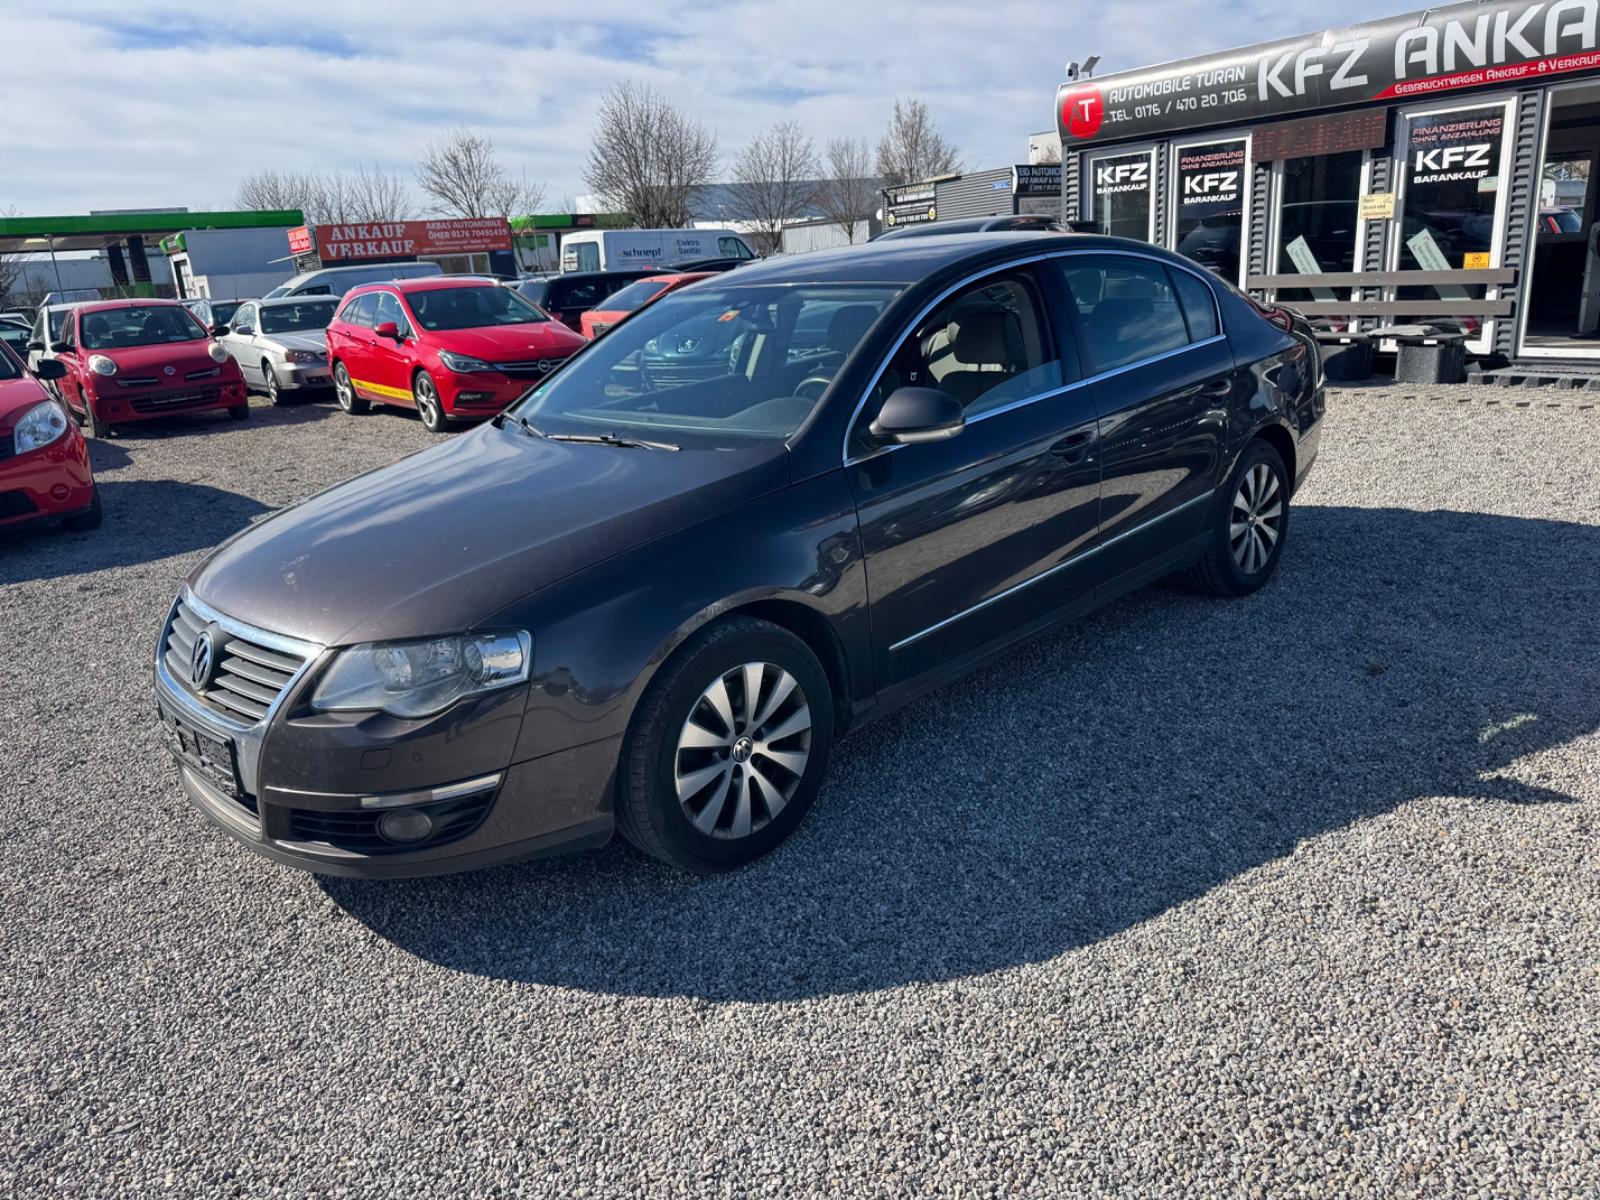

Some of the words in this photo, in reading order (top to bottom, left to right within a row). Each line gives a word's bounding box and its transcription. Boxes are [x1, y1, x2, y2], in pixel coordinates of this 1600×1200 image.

[1257, 38, 1371, 101] KFZ
[1109, 76, 1191, 104] AUTOMOBILE
[1196, 66, 1247, 87] TURAN
[1110, 110, 1132, 123] TEL.
[1135, 103, 1161, 119] 0176
[1176, 98, 1197, 111] 470
[1201, 94, 1218, 107] 20
[1222, 88, 1247, 103] 706
[1412, 118, 1502, 136] FINANZIERUNG
[1412, 134, 1437, 143] OHNE
[1440, 127, 1501, 140] ANZAHLUNG
[1181, 150, 1244, 163] FINANZIERUNG
[1201, 158, 1244, 168] ANZAHLUNG
[1415, 143, 1491, 172] KFZ
[1097, 162, 1148, 185] KFZ
[1413, 170, 1488, 184] BARANKAUF
[1096, 183, 1147, 195] BARANKAUF
[1184, 171, 1238, 194] KFZ
[1183, 193, 1237, 204] BARANKAUF
[331, 224, 406, 241] ANKAUF
[426, 221, 451, 229] AKBAS
[453, 220, 502, 229] AUTOMOBILE
[451, 230, 470, 238] 0176
[326, 239, 415, 257] VERKAUF
